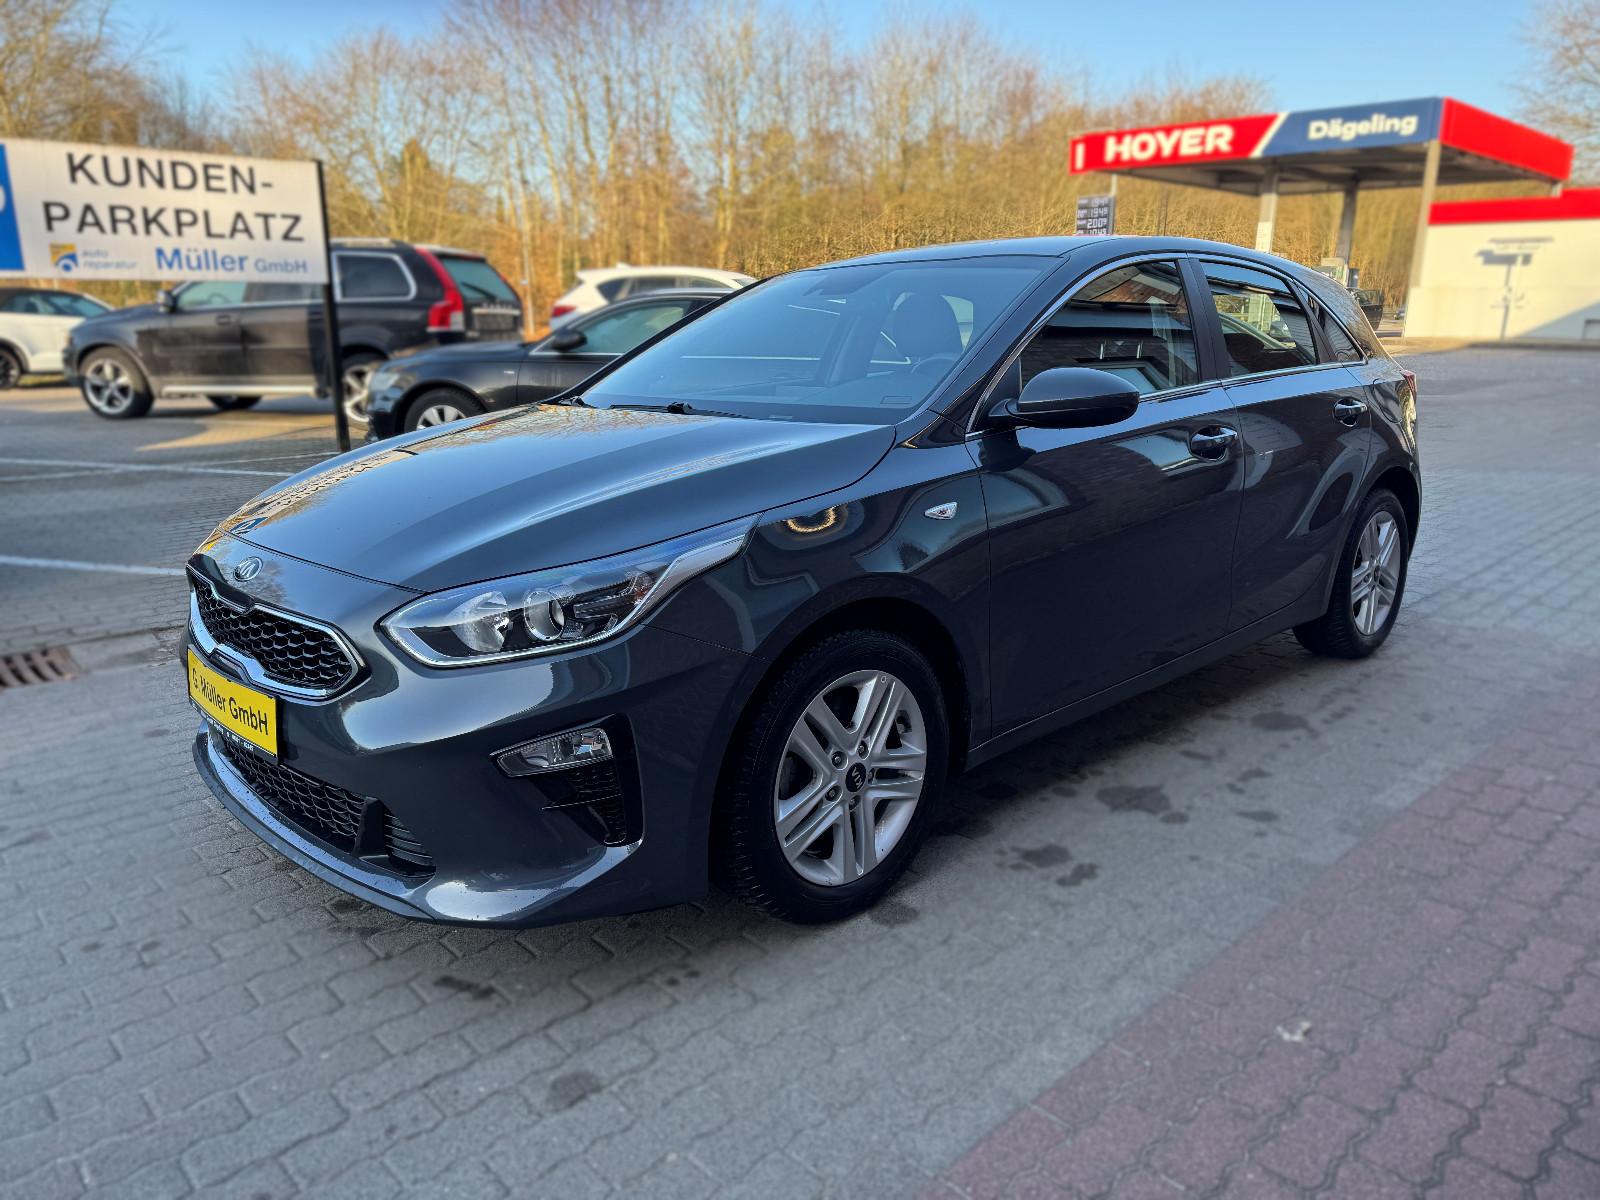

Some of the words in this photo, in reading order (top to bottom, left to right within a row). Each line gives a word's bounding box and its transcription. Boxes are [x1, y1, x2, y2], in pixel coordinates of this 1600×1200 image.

[1104, 125, 1234, 163] HOYER
[1307, 113, 1418, 141] Dägeling
[66, 152, 273, 195] KUNDEN-
[43, 201, 305, 242] PARKPLATZ
[155, 247, 250, 272] Müller
[254, 257, 308, 274] GmbH
[200, 675, 226, 712] Müller
[229, 696, 269, 736] GmbH
